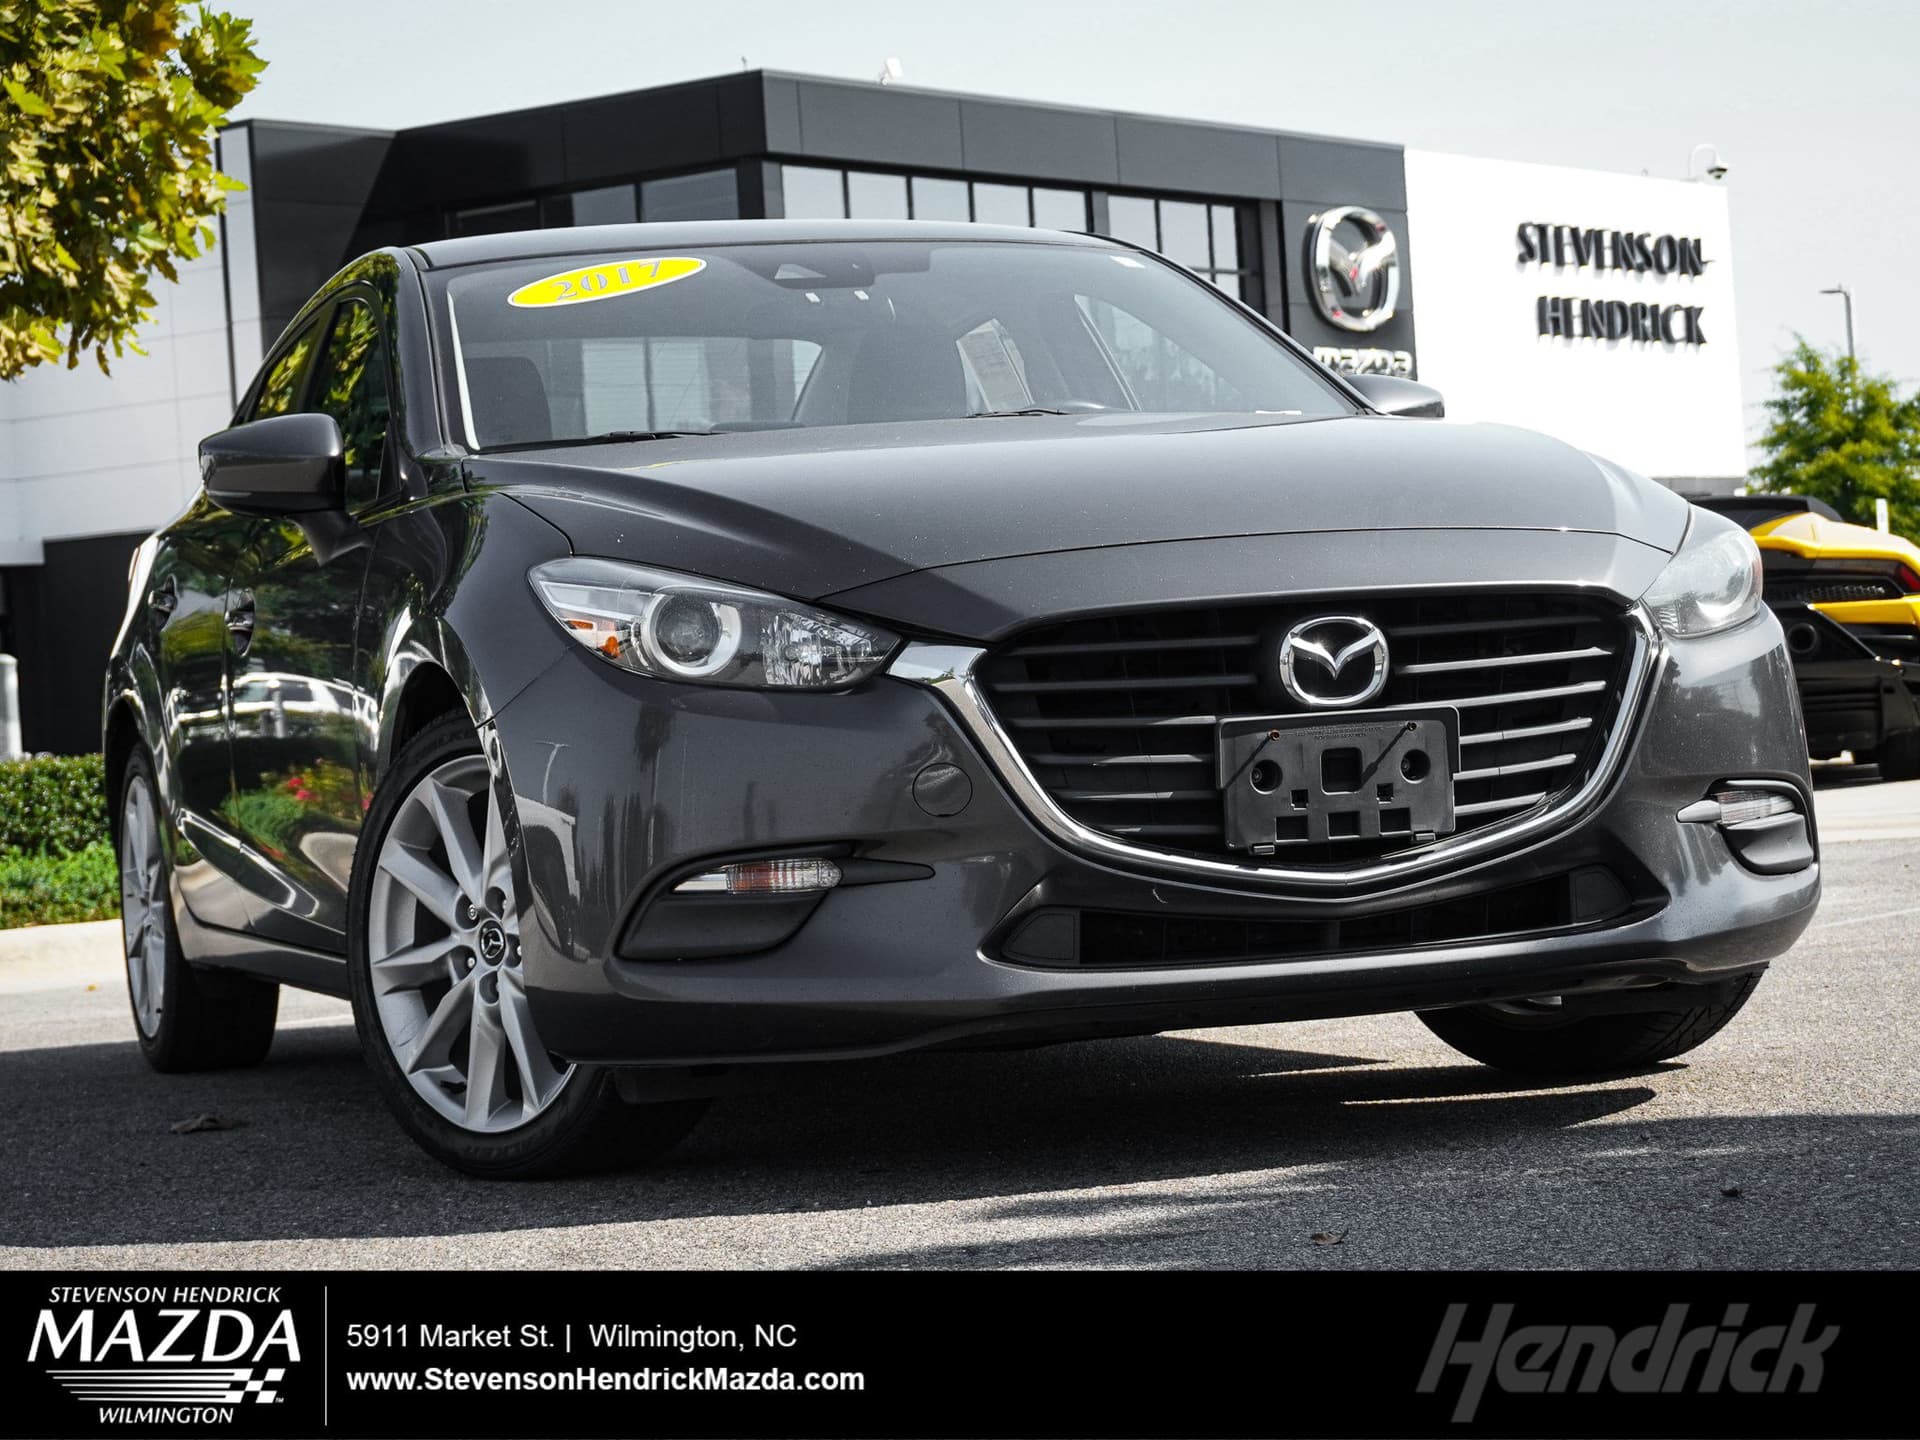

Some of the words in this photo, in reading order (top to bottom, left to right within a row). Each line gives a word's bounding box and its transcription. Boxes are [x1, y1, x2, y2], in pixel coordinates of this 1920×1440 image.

[1517, 221, 1713, 276] STEVENSON
[552, 259, 662, 301] 2017
[1537, 296, 1706, 345] HENDRICK
